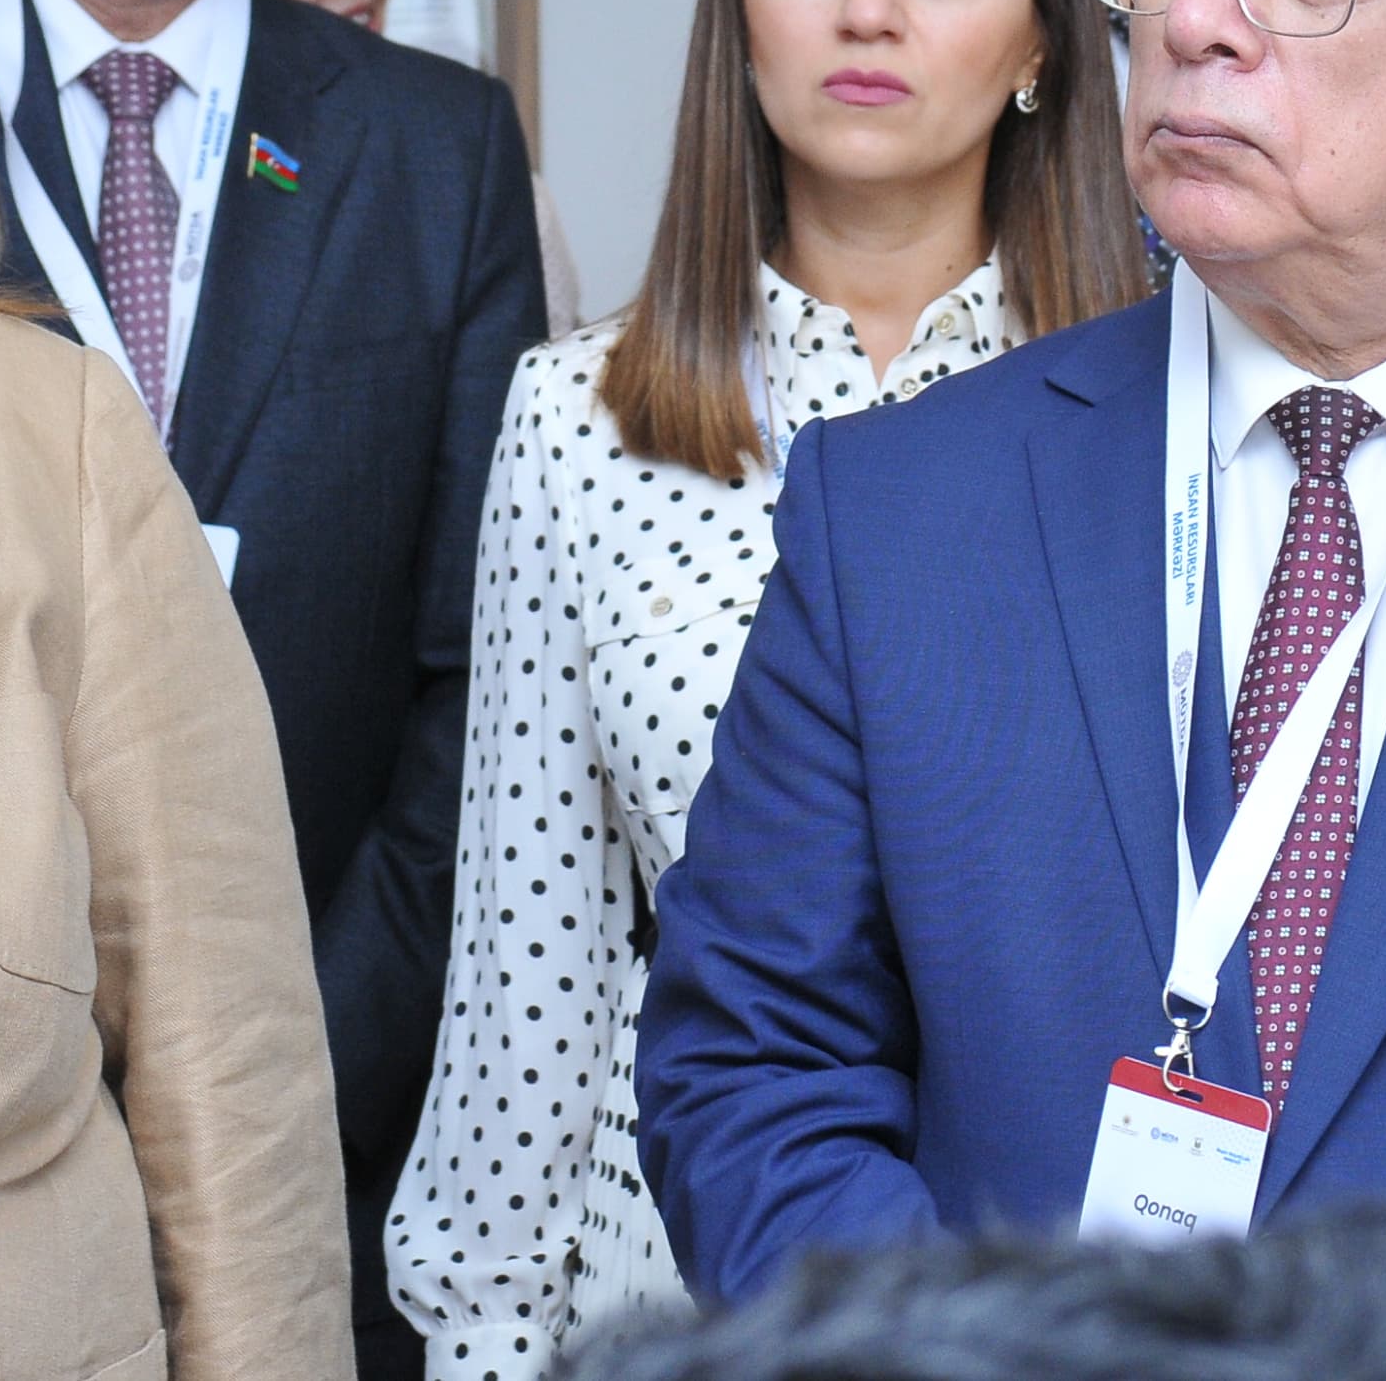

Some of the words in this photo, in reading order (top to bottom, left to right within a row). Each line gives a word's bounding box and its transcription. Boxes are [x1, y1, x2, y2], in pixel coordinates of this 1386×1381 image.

[1188, 472, 1201, 519] İNSAN
[1173, 511, 1184, 579] MƏRKƏZİ
[1185, 522, 1199, 606] RESURSLARI
[1134, 1194, 1197, 1235] Qonaq
